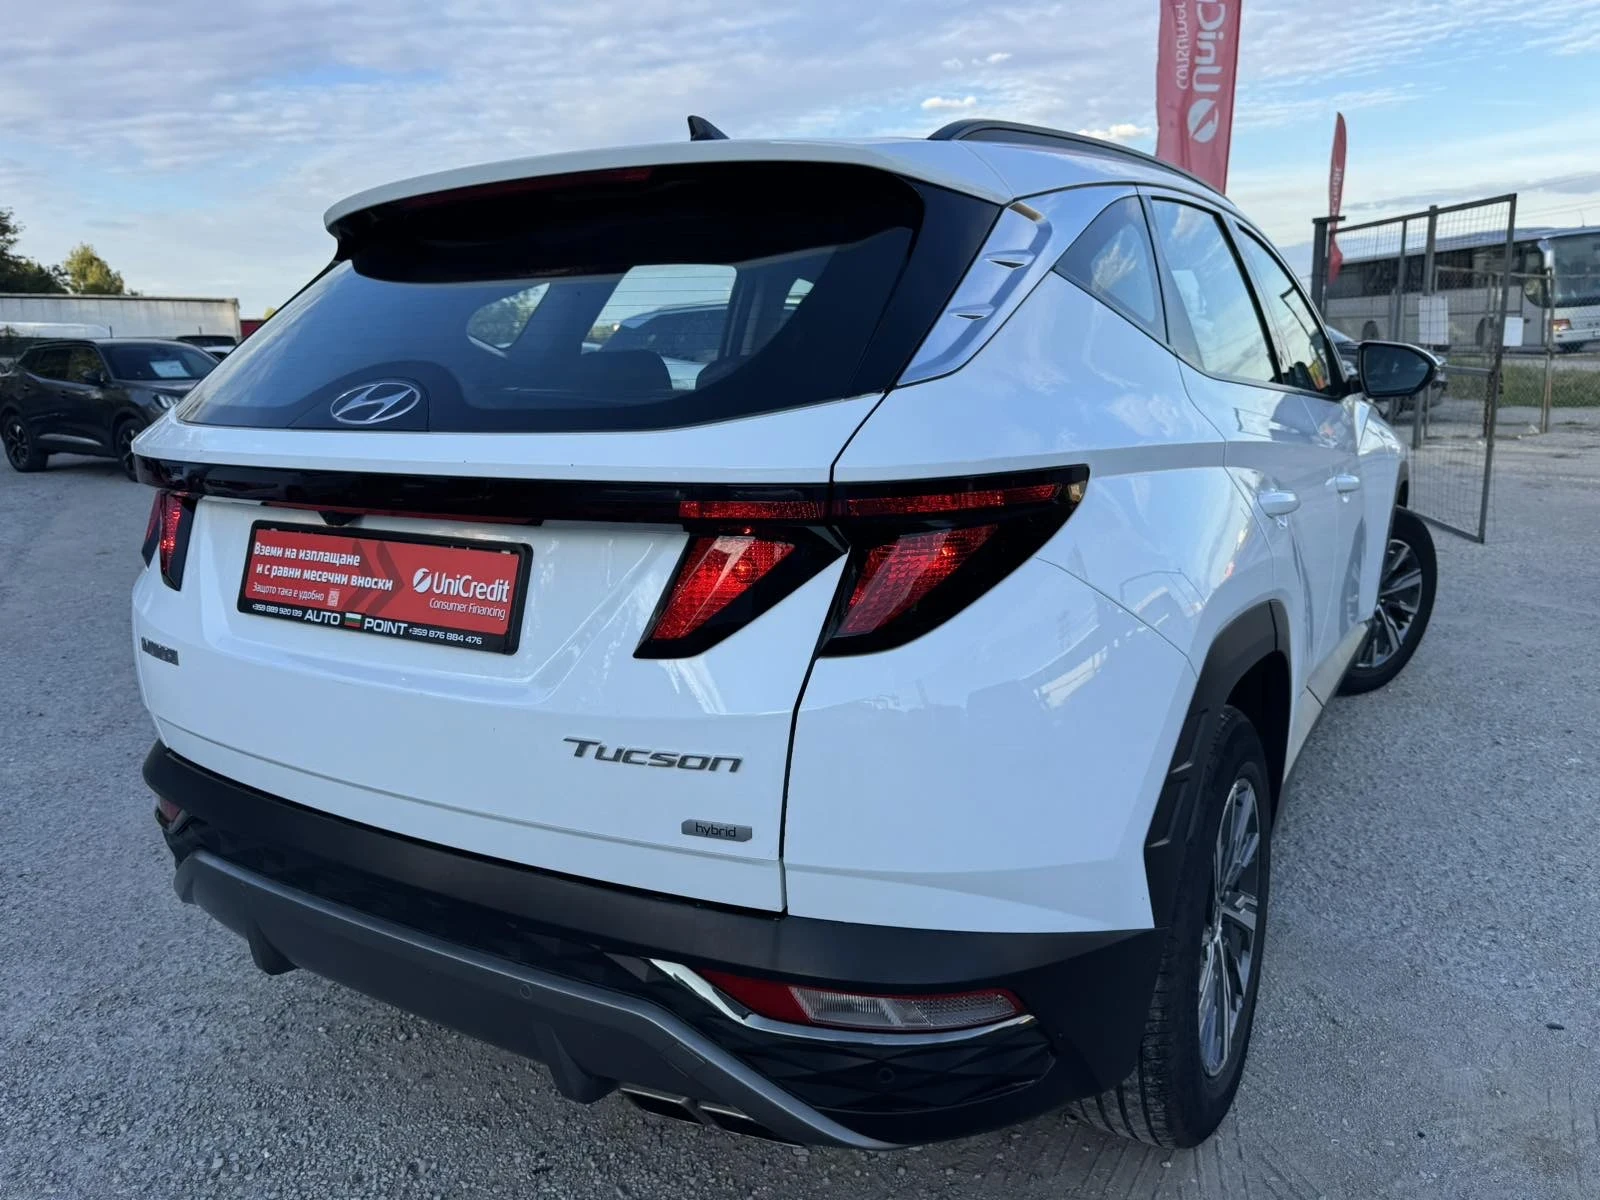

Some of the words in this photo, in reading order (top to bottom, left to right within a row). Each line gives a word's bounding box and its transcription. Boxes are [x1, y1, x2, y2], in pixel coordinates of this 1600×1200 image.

[253, 541, 283, 558] Вземи
[284, 547, 297, 559] на
[298, 549, 361, 567] изплащане
[256, 563, 263, 574] и
[264, 564, 270, 575] с
[271, 565, 301, 579] равни
[302, 569, 349, 586] месечни
[350, 575, 394, 592] вноски
[432, 571, 510, 603] UniCredit
[252, 582, 277, 594] Защото
[277, 586, 293, 597] така
[298, 589, 325, 601] удобно
[429, 597, 468, 613] Consumer
[468, 603, 506, 621] Financing
[304, 609, 341, 625] AUTO
[364, 617, 408, 636] POINT
[408, 626, 428, 637] +359
[428, 629, 446, 640] 876
[465, 636, 483, 645] 476
[562, 736, 744, 774] Tucson
[695, 821, 737, 839] hybrid
